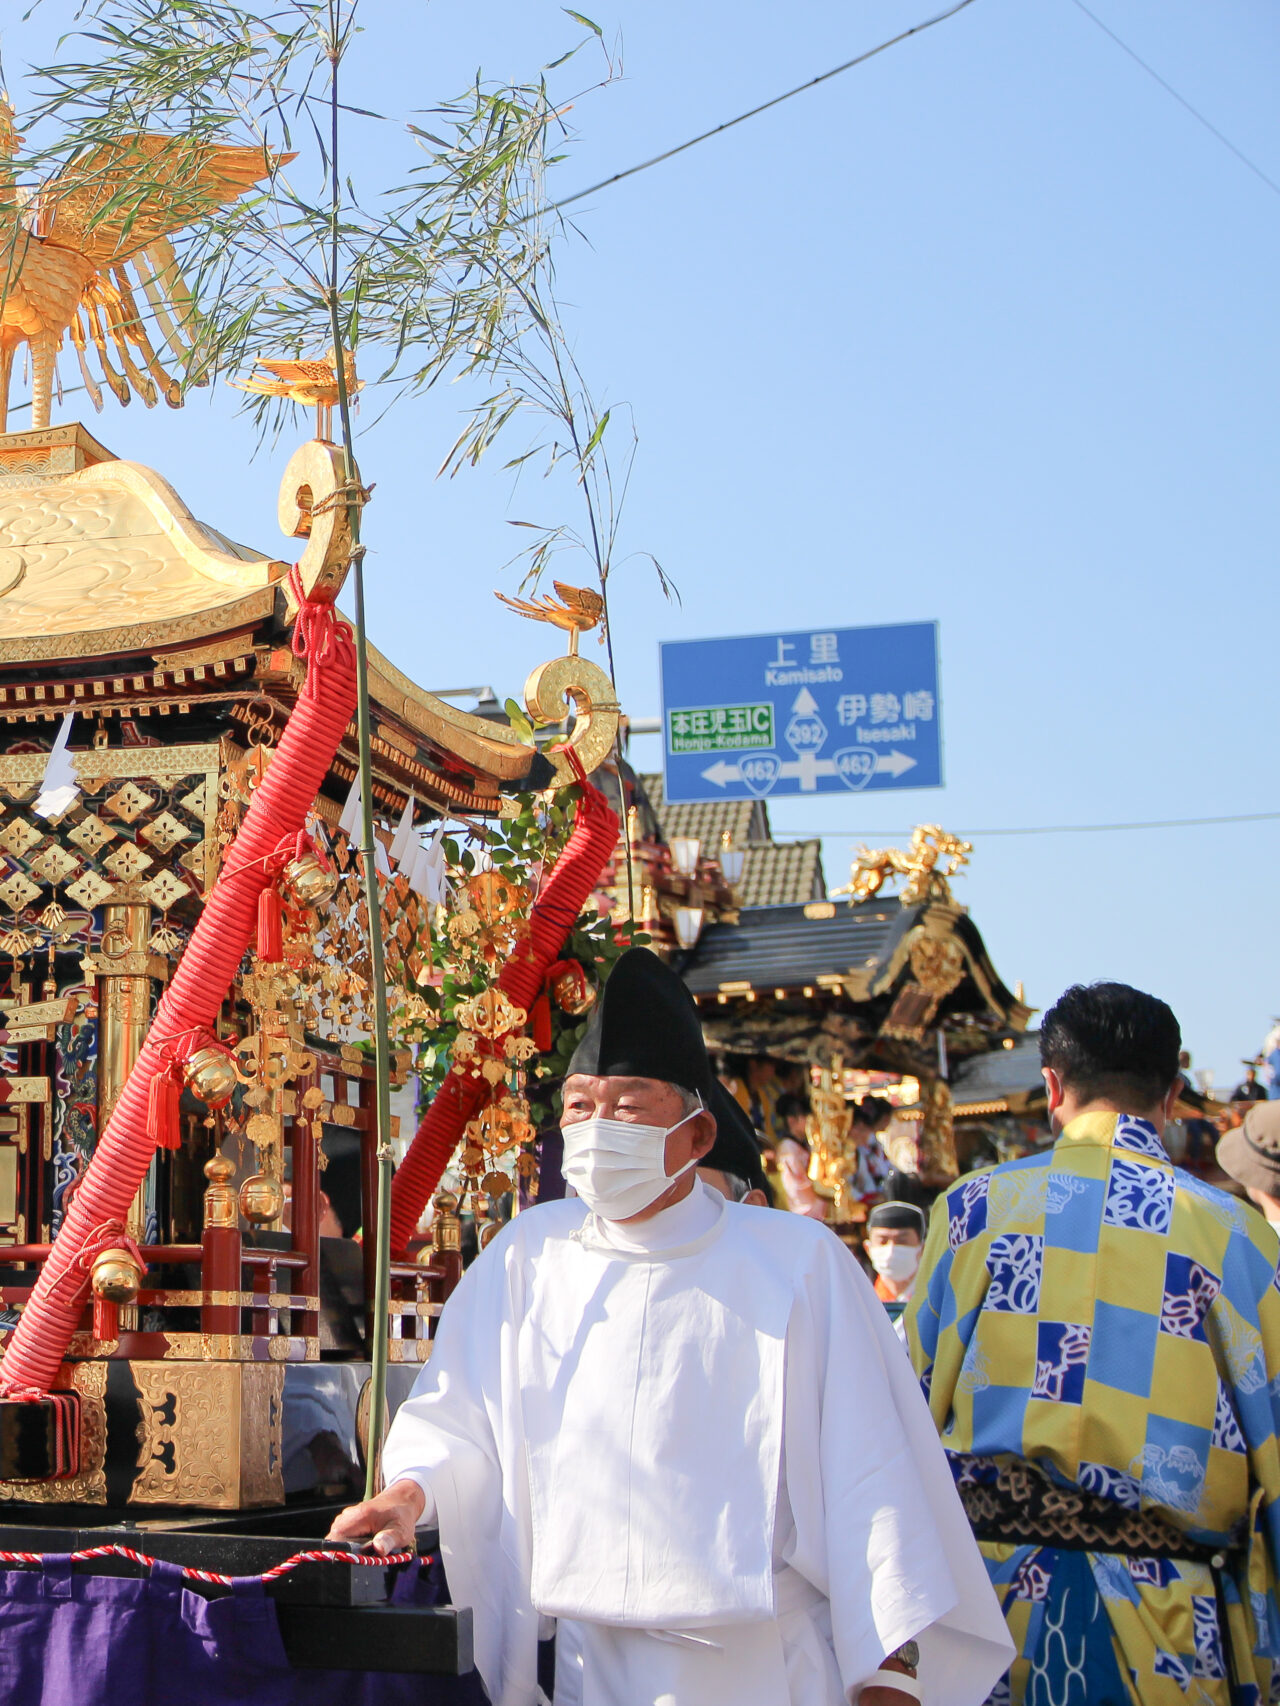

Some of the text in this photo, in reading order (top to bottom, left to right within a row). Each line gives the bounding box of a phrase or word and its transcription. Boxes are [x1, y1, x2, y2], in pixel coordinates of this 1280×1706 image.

[767, 633, 840, 668] 上里
[765, 666, 843, 687] Kamisato
[837, 690, 934, 726] 伊勢崎
[674, 733, 771, 751] Honjo-Kodama
[789, 723, 822, 745] 392
[856, 722, 916, 744] Isesaki
[745, 760, 777, 782] 462
[840, 754, 872, 777] 462
